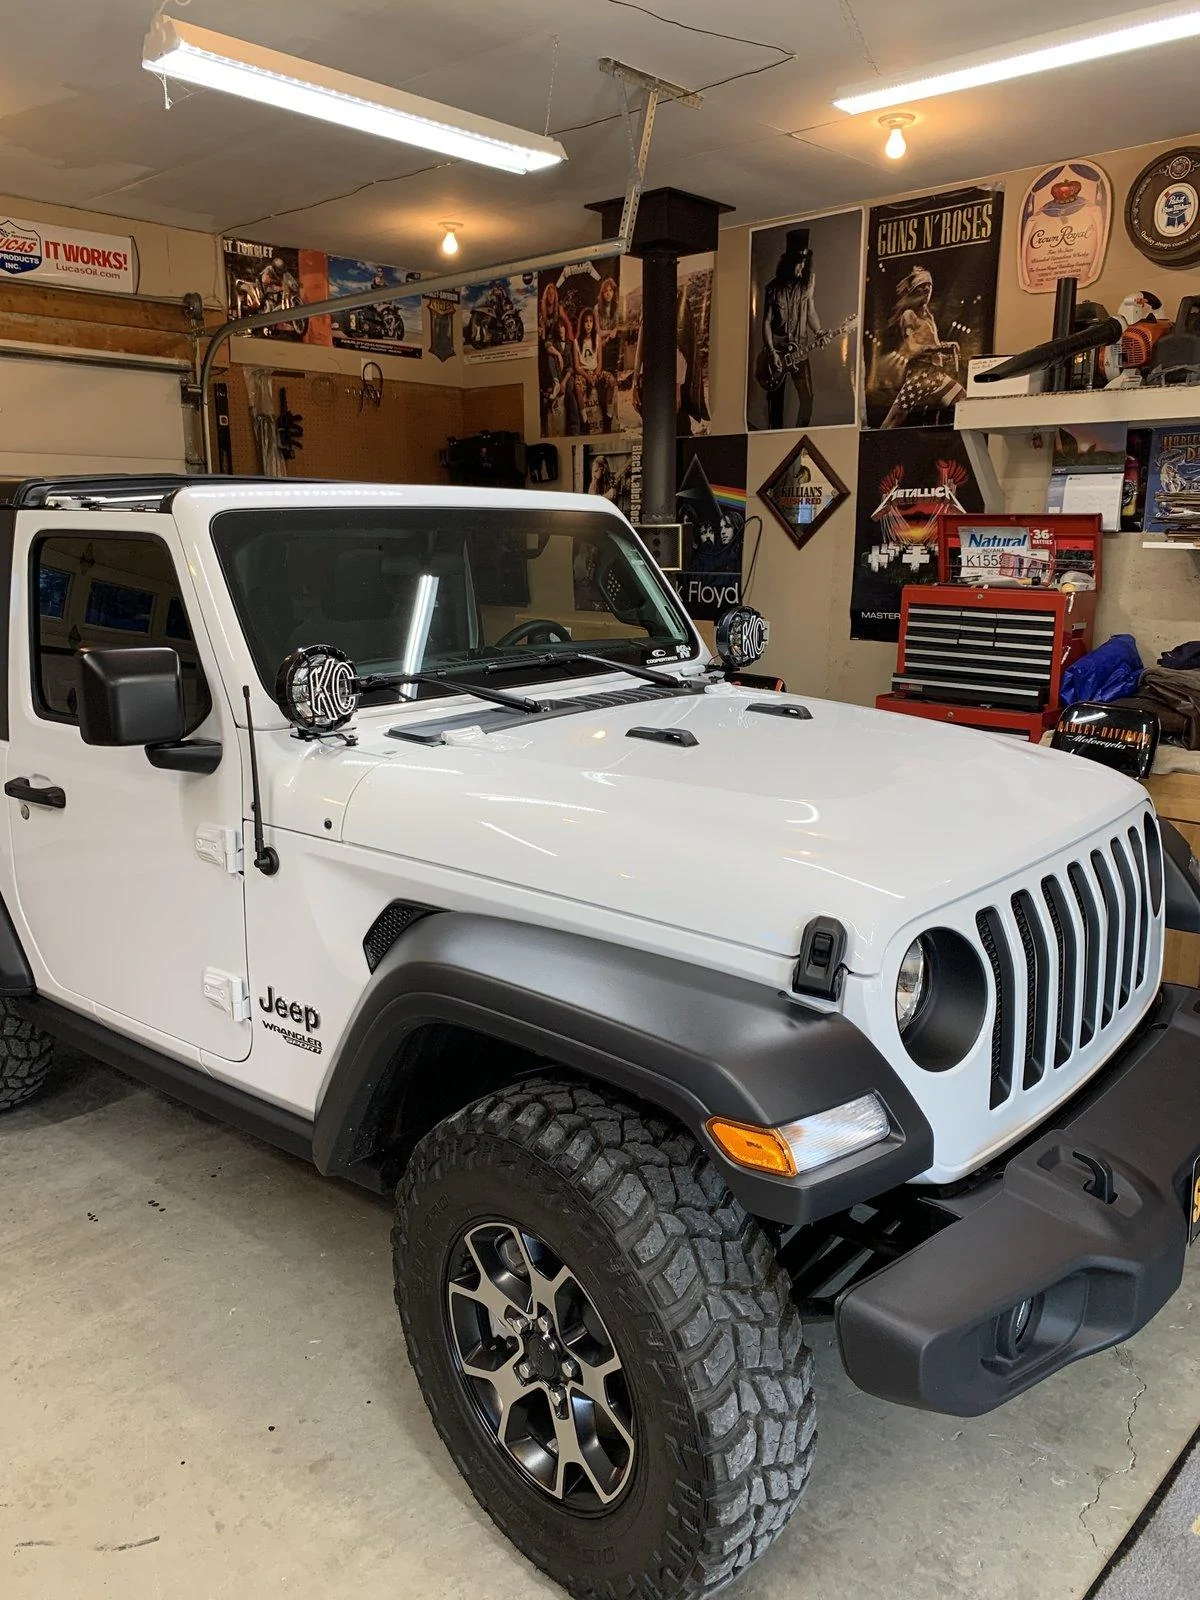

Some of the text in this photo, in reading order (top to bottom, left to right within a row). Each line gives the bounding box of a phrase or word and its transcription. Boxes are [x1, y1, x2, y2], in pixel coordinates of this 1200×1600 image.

[878, 203, 993, 256] GUNS N' ROSES
[1030, 226, 1091, 249] Crown Royal
[0, 237, 37, 253] UCAS
[45, 240, 128, 271] IT WORKS!
[0, 252, 40, 265] PRODUCTS
[56, 263, 121, 280] LucasOil.com
[631, 445, 643, 473] Black
[630, 474, 642, 503] Label
[781, 486, 823, 498] KILLIAN'S
[805, 497, 822, 505] RED
[968, 533, 1028, 548] Natural
[1033, 530, 1050, 539] 36
[688, 581, 739, 608] Floyd
[861, 611, 901, 620] MASTER
[742, 615, 766, 659] KC
[309, 658, 356, 720] KC
[1068, 735, 1127, 750] Motorcycles
[259, 986, 321, 1033] Jeep
[262, 1020, 322, 1048] WRANGLER
